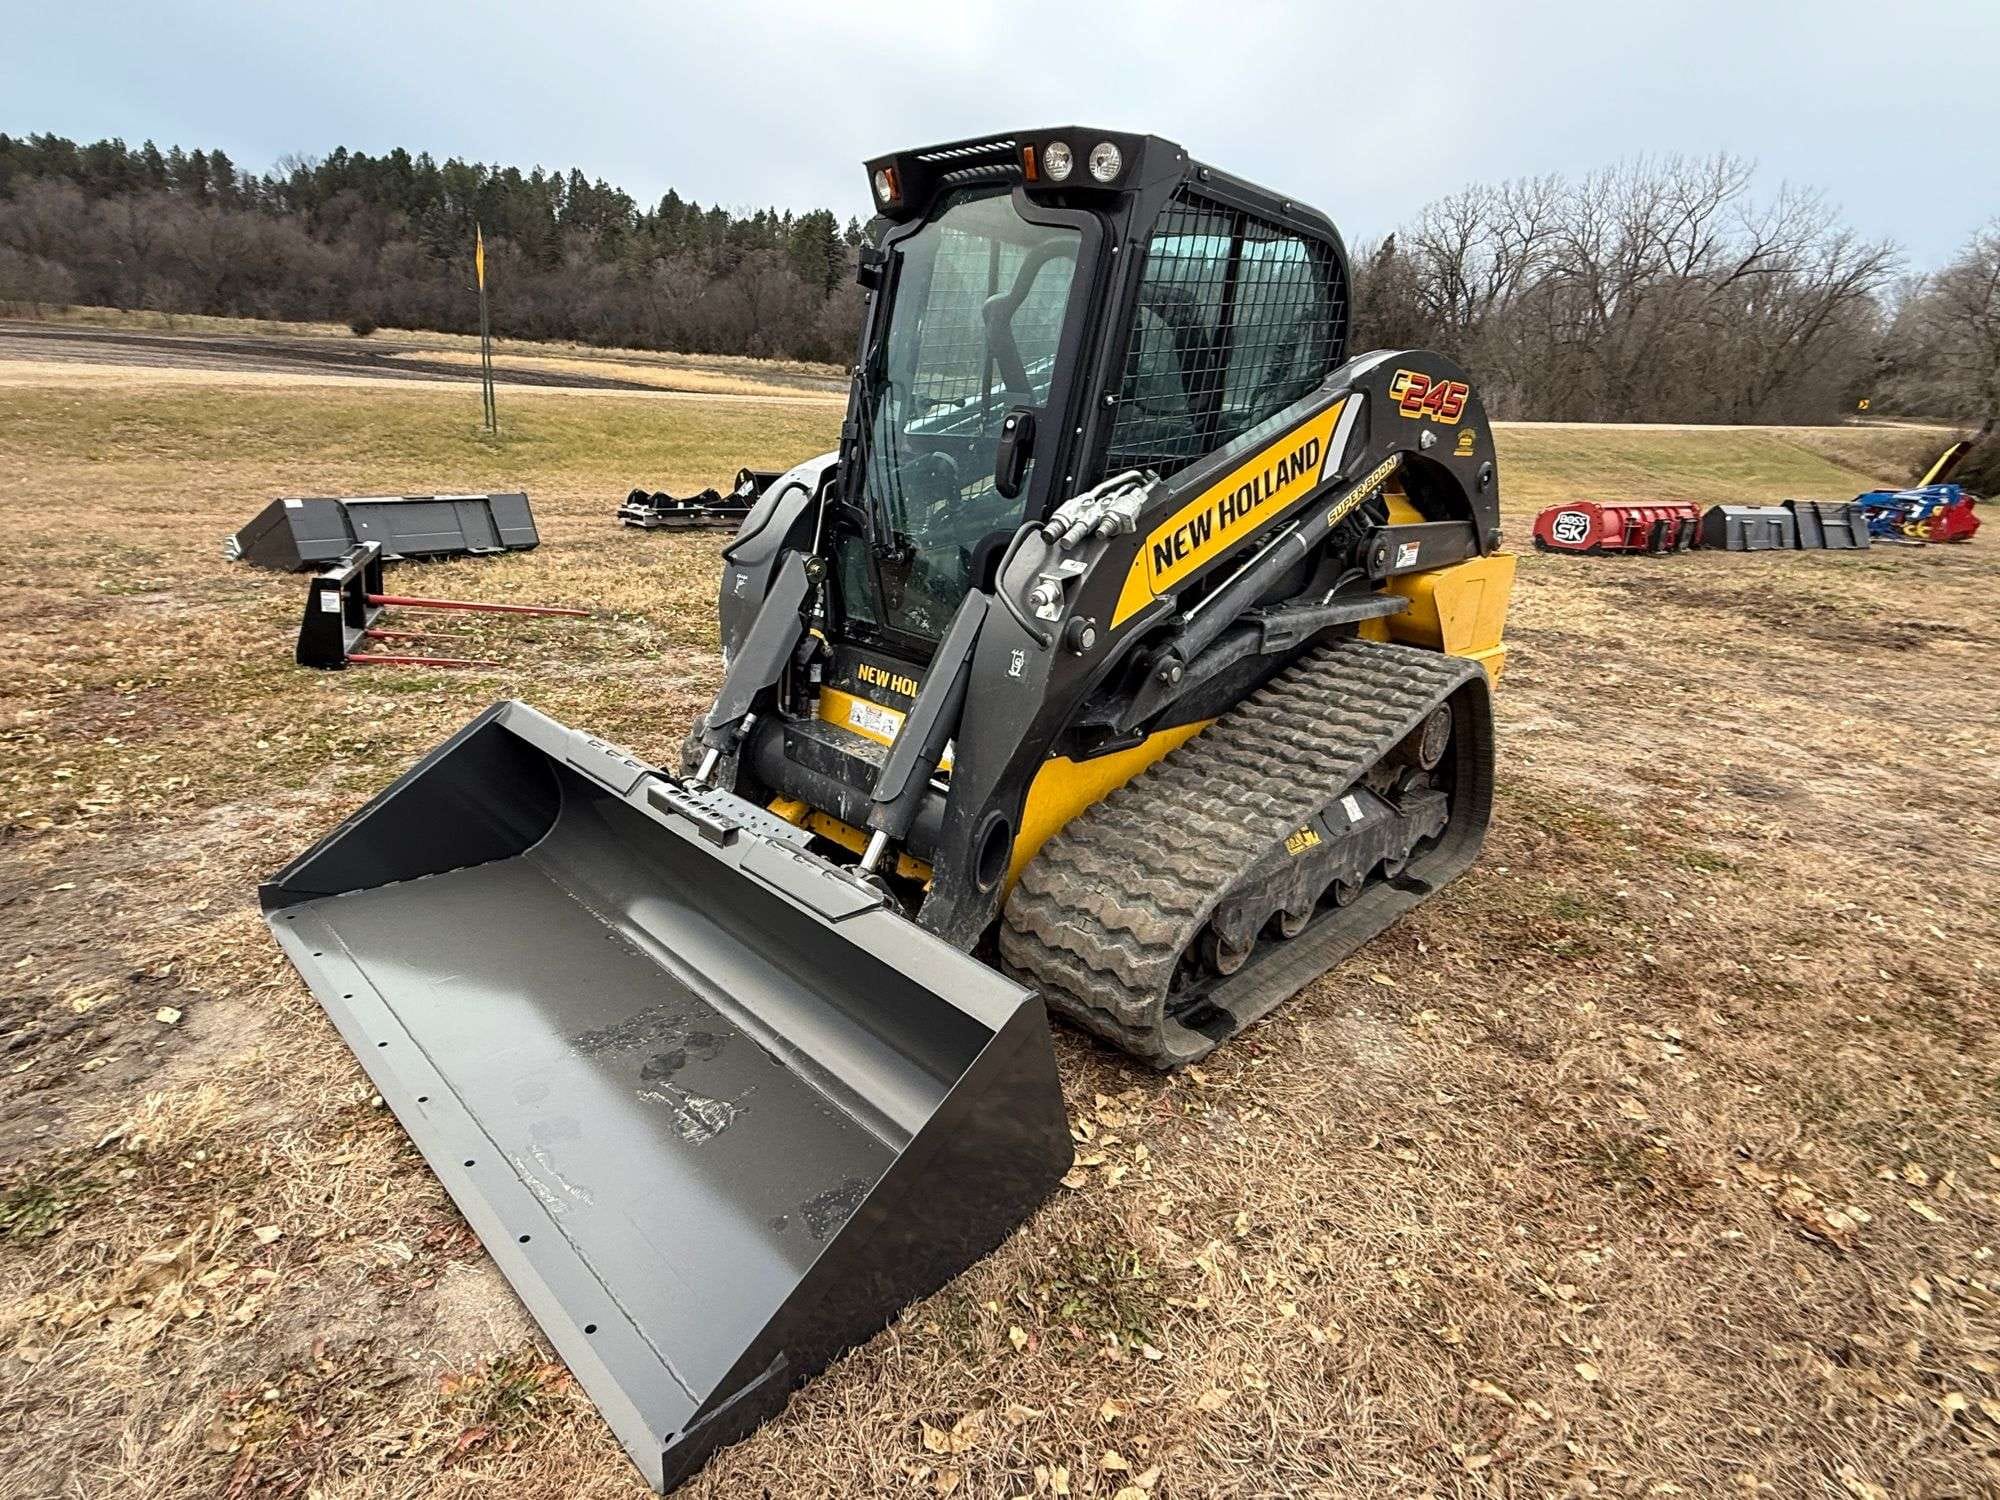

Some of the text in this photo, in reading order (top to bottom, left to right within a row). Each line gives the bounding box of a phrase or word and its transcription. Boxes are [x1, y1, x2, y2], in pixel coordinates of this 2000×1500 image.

[1389, 369, 1469, 424] C245
[1152, 436, 1320, 577] NEW HOLLAND
[1327, 483, 1366, 527] SUPER
[1559, 514, 1587, 526] BOSS
[1556, 524, 1585, 541] SK
[858, 663, 890, 688] NEW
